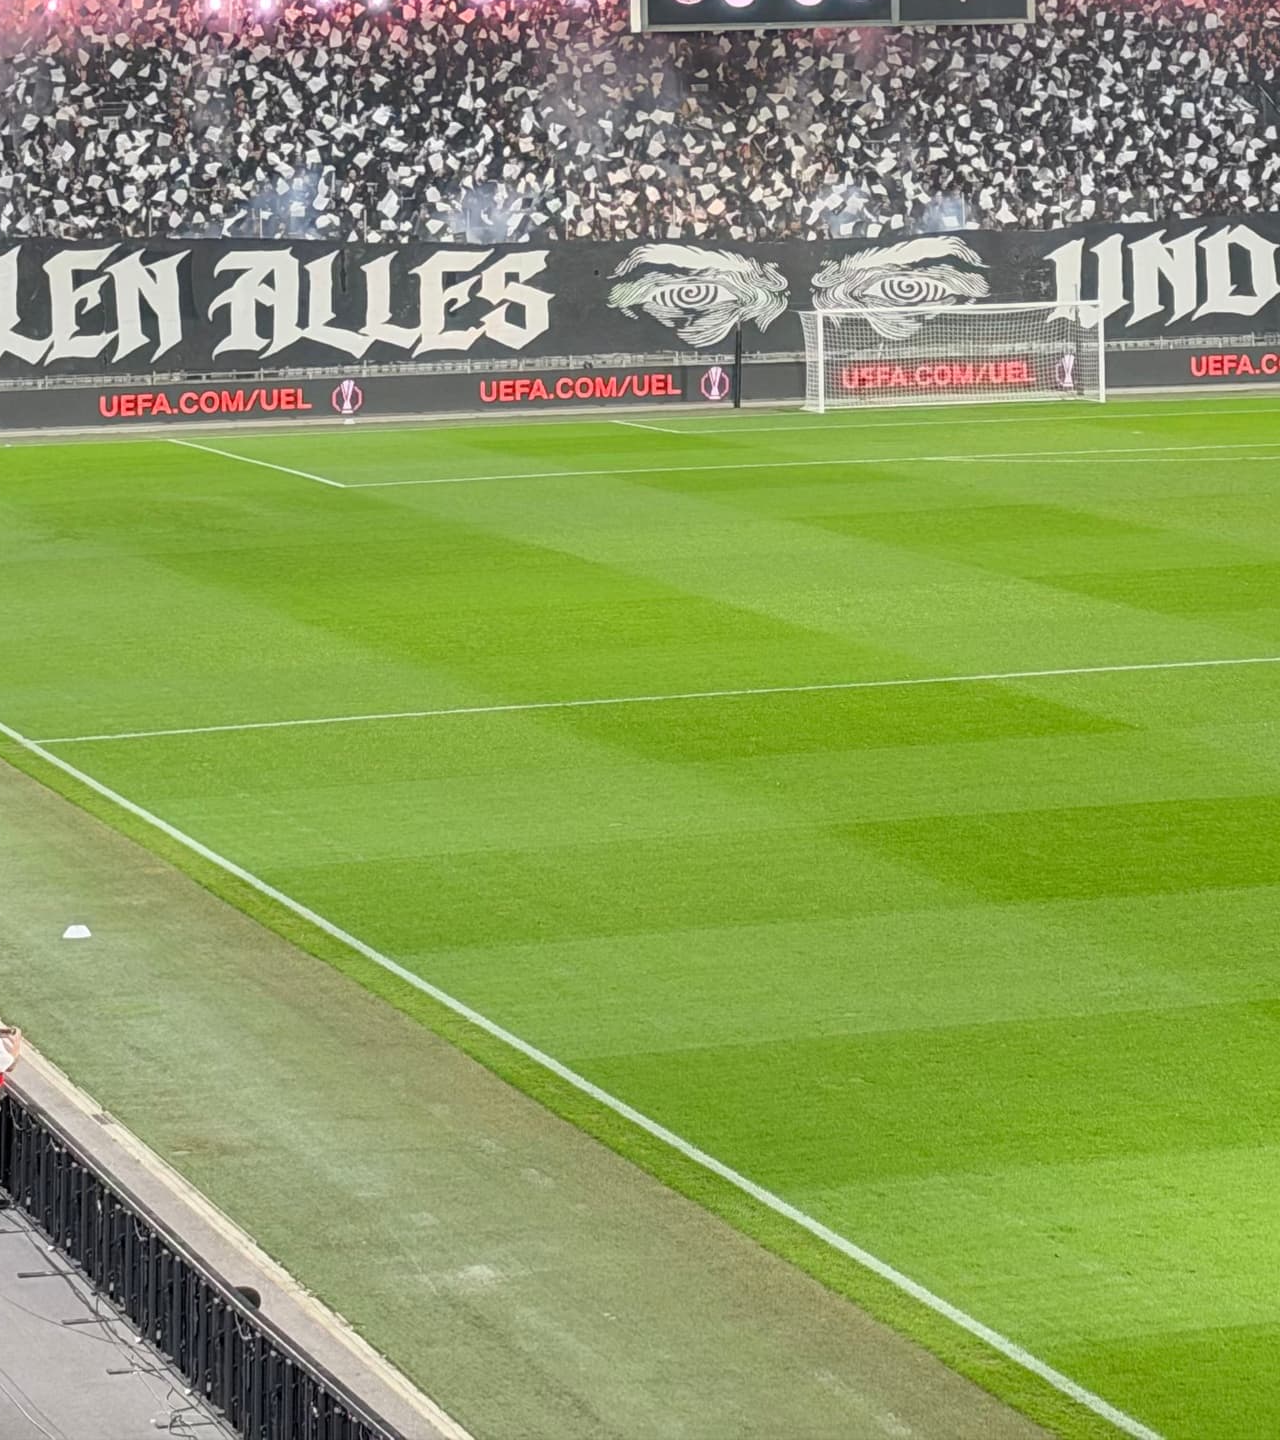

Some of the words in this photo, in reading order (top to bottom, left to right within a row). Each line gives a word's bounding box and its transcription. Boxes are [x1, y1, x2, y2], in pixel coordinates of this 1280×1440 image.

[206, 248, 554, 360] ALLES
[479, 373, 681, 402] UEFA.COM/UEL
[99, 388, 312, 418] UEFA.COM/UEL
